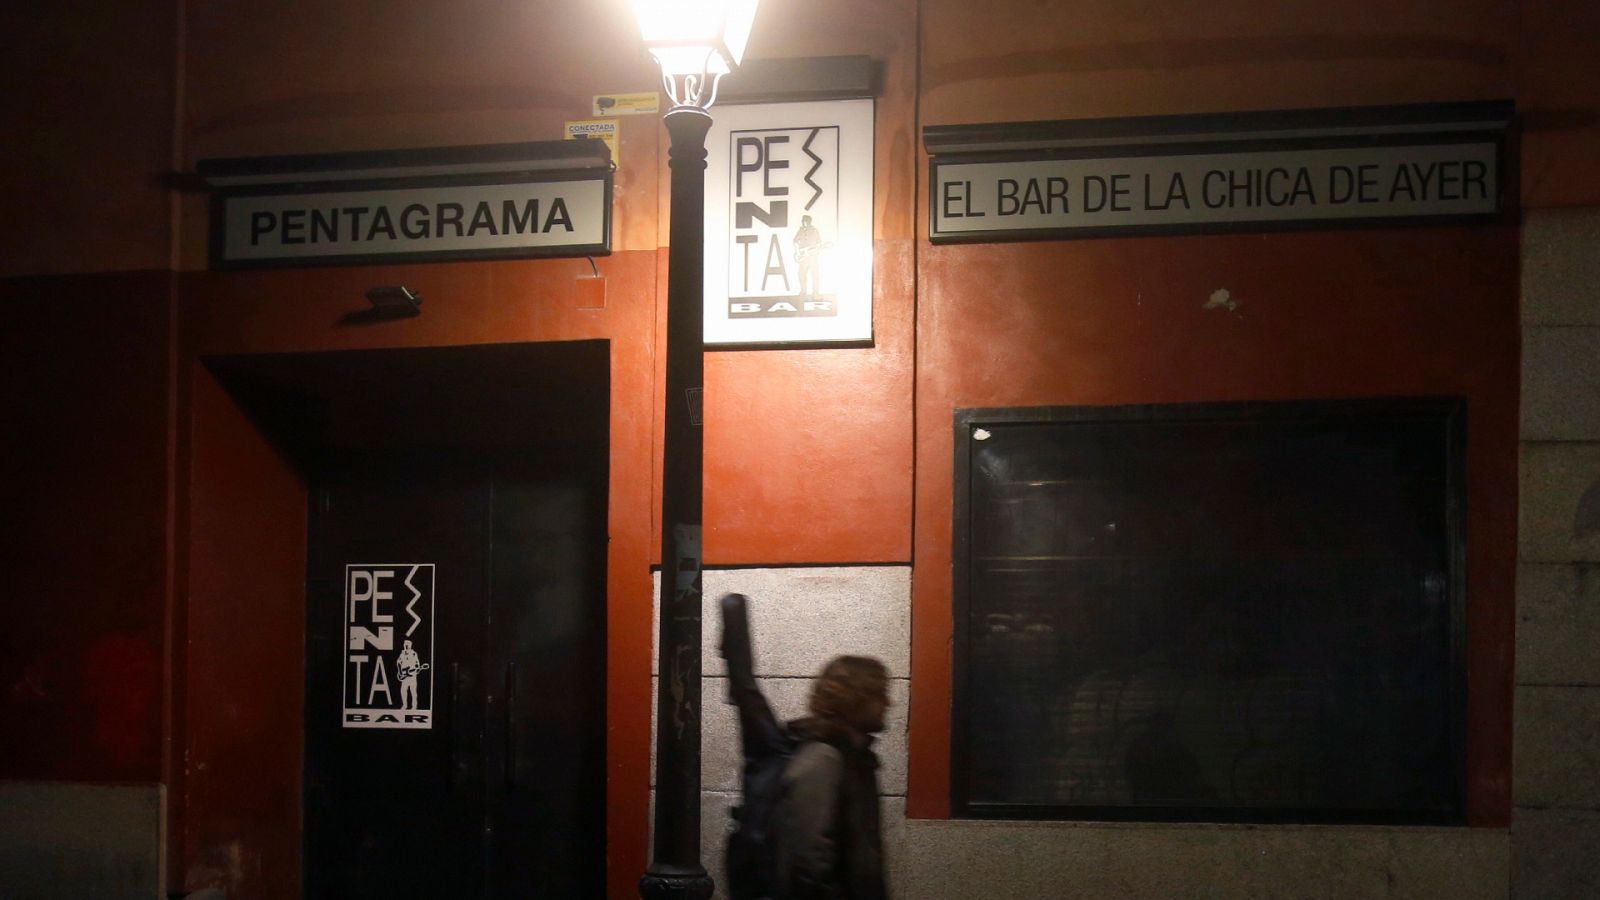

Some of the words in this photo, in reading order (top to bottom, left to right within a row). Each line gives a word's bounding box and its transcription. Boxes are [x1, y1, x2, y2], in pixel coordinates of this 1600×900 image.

[568, 124, 615, 132] CONECTADA
[943, 181, 985, 218] EL
[997, 177, 1069, 216] BAR
[1083, 174, 1131, 213] DE
[1144, 172, 1190, 210] LA
[1202, 167, 1316, 208] CHICA
[1329, 164, 1379, 204] DE
[1389, 160, 1488, 202] AYER
[251, 197, 575, 246] PENTAGRAMA
[731, 301, 833, 313] BAR
[346, 714, 429, 723] BAR
